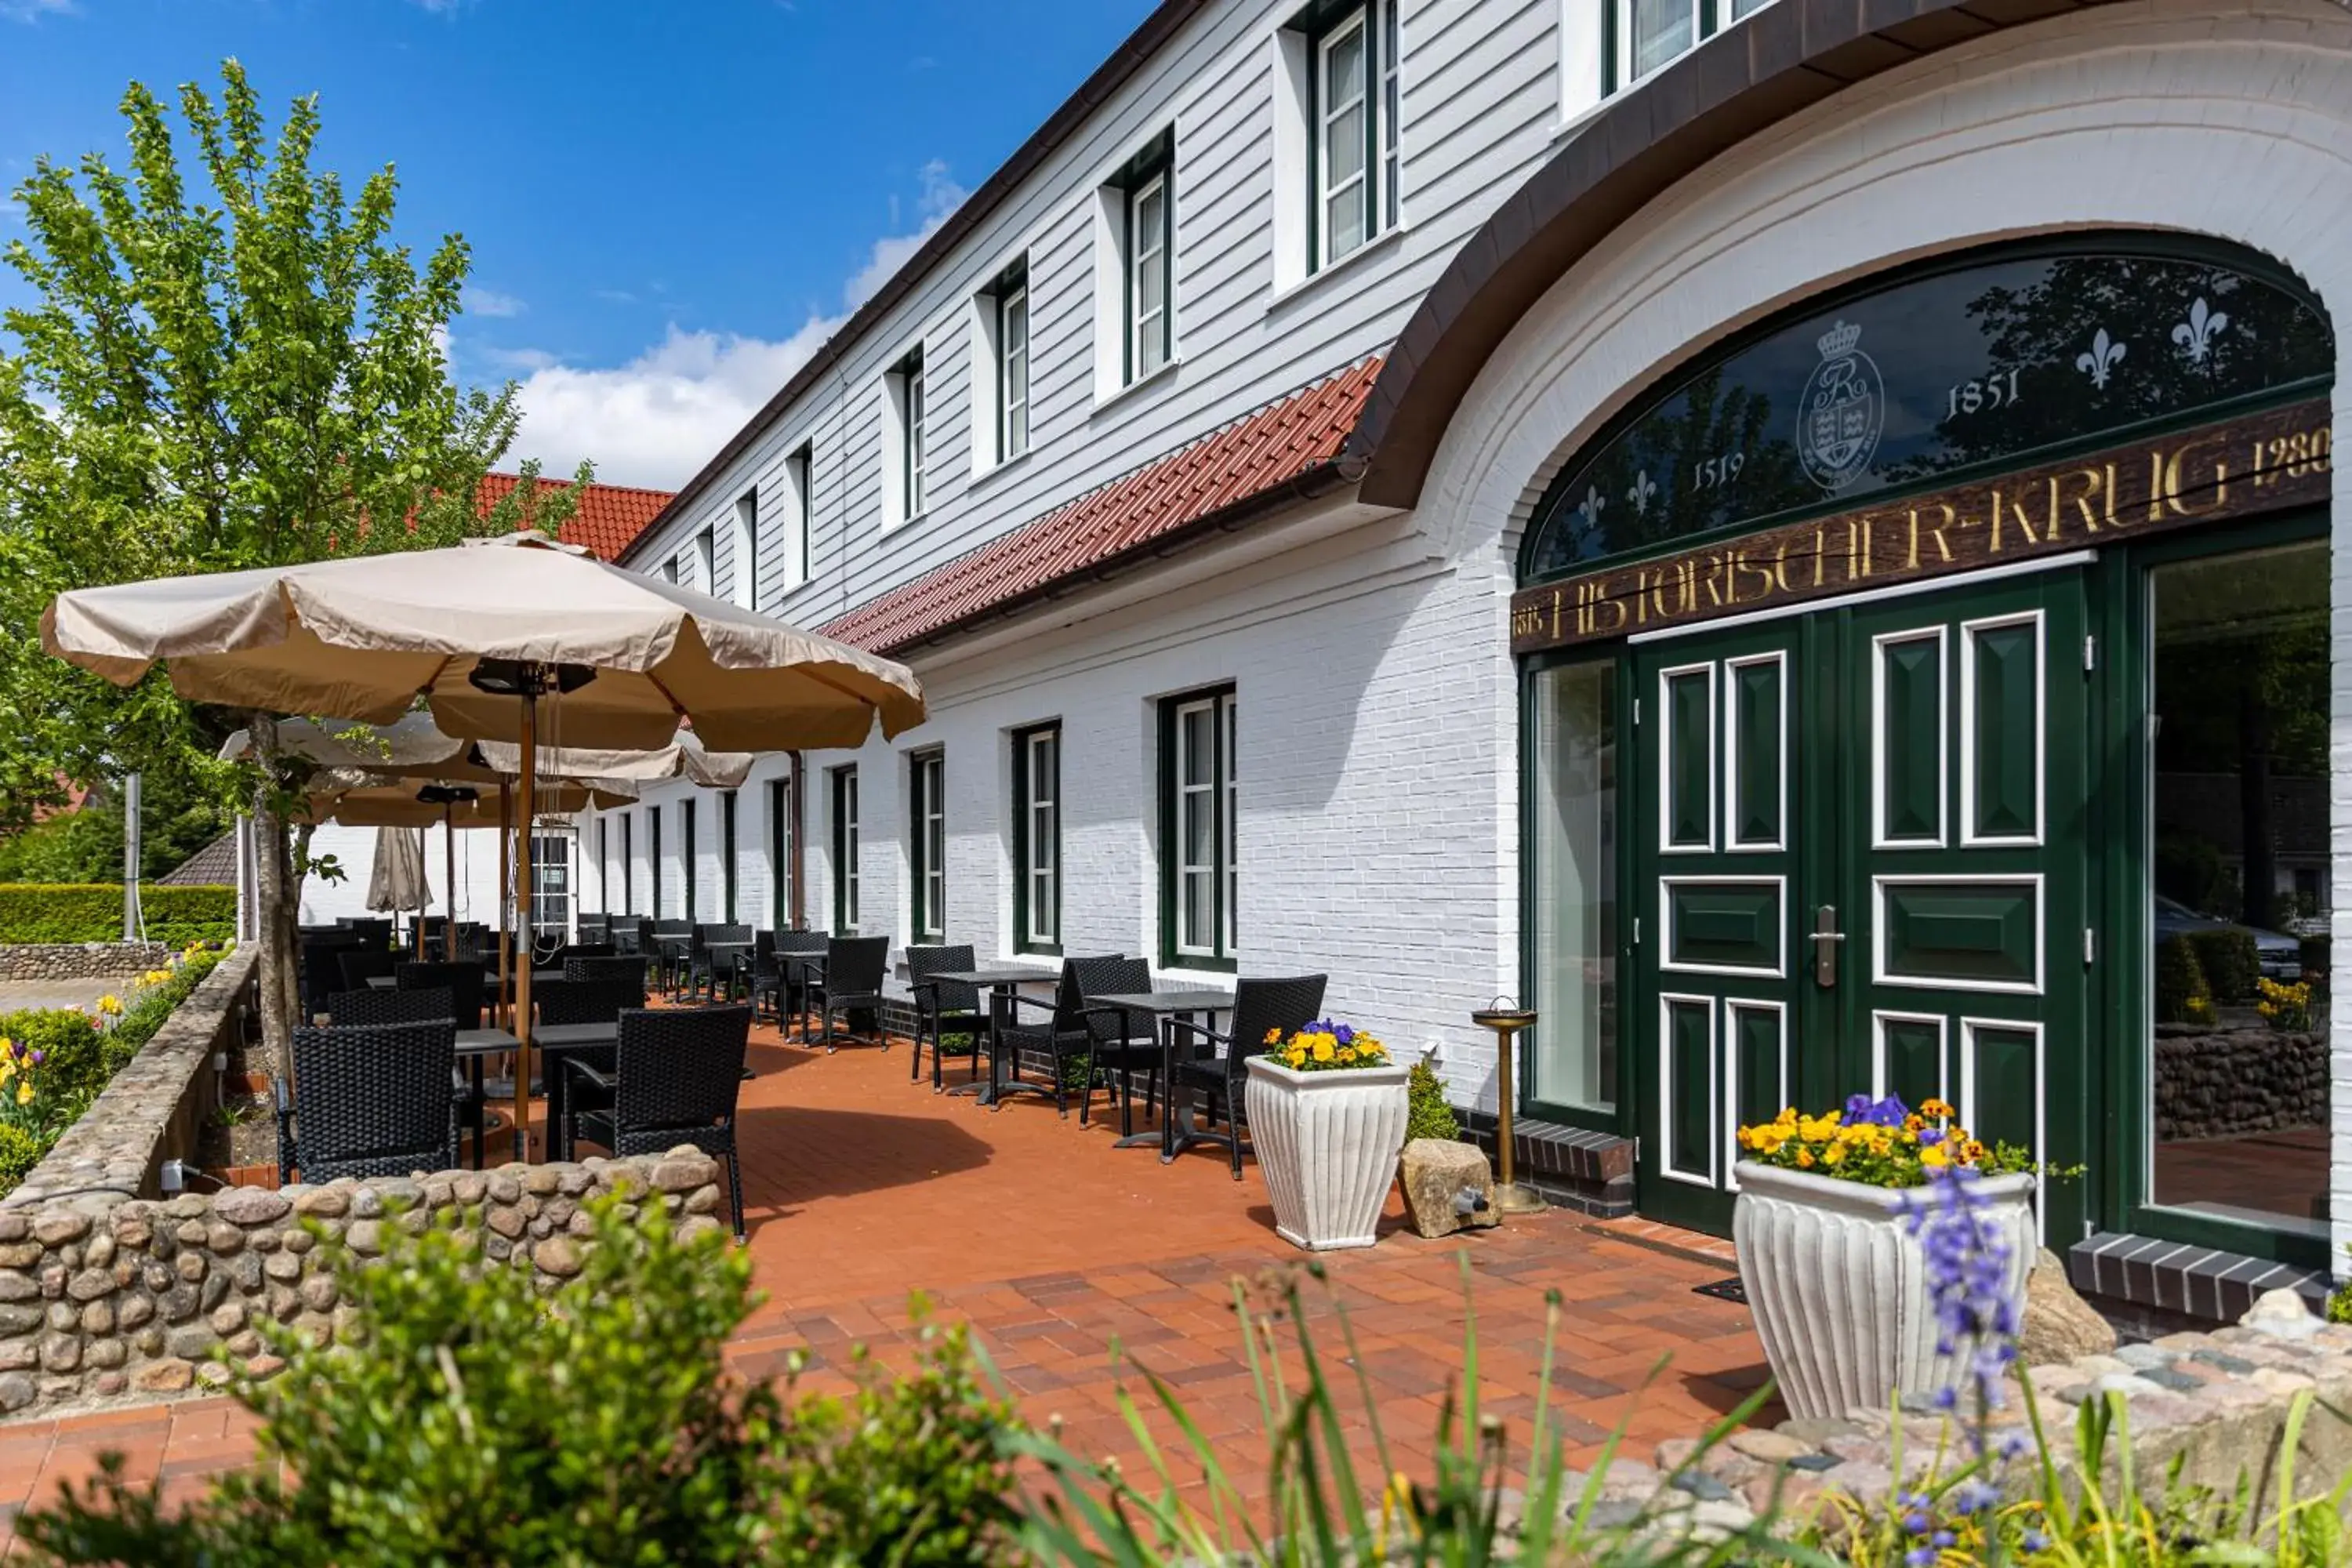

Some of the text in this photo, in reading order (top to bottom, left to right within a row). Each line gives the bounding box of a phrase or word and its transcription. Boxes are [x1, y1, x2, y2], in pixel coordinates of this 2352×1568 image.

[1945, 368, 2020, 423] 1851
[1693, 452, 1744, 492] 1519
[2252, 426, 2331, 487] 1980
